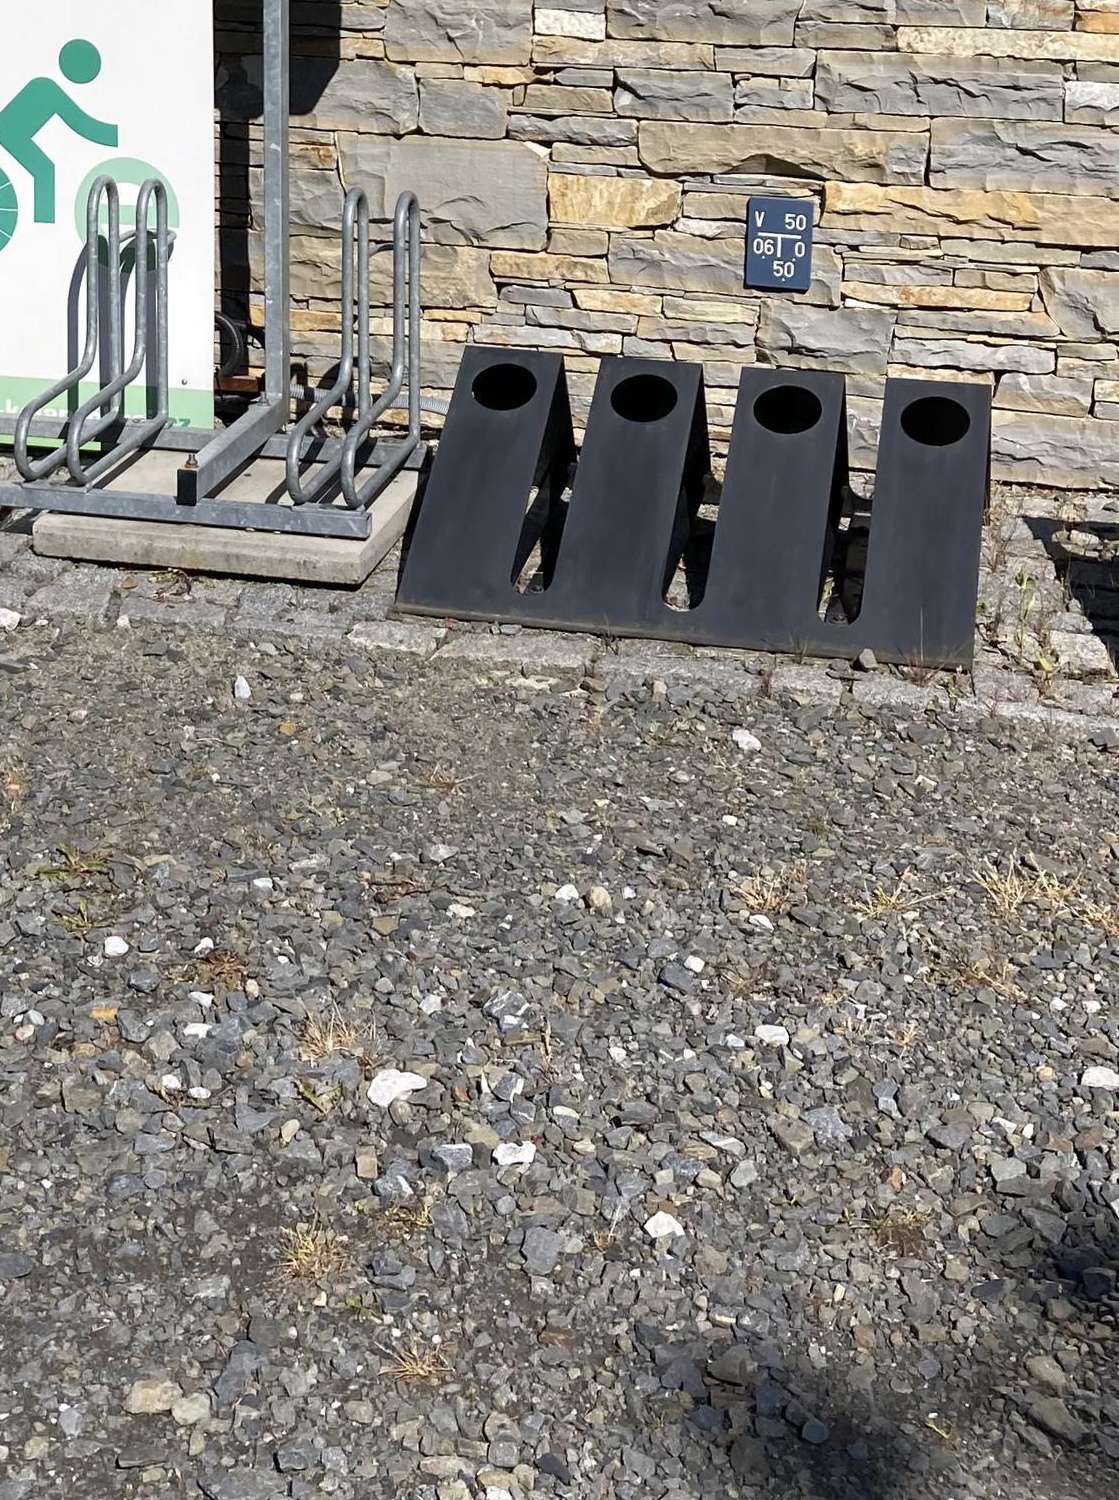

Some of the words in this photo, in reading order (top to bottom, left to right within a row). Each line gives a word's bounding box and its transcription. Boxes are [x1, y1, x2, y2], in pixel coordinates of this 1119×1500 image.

[755, 211, 765, 228] V
[785, 213, 807, 230] 50
[753, 238, 775, 255] 06
[794, 241, 806, 258] 0
[773, 260, 795, 278] 50
